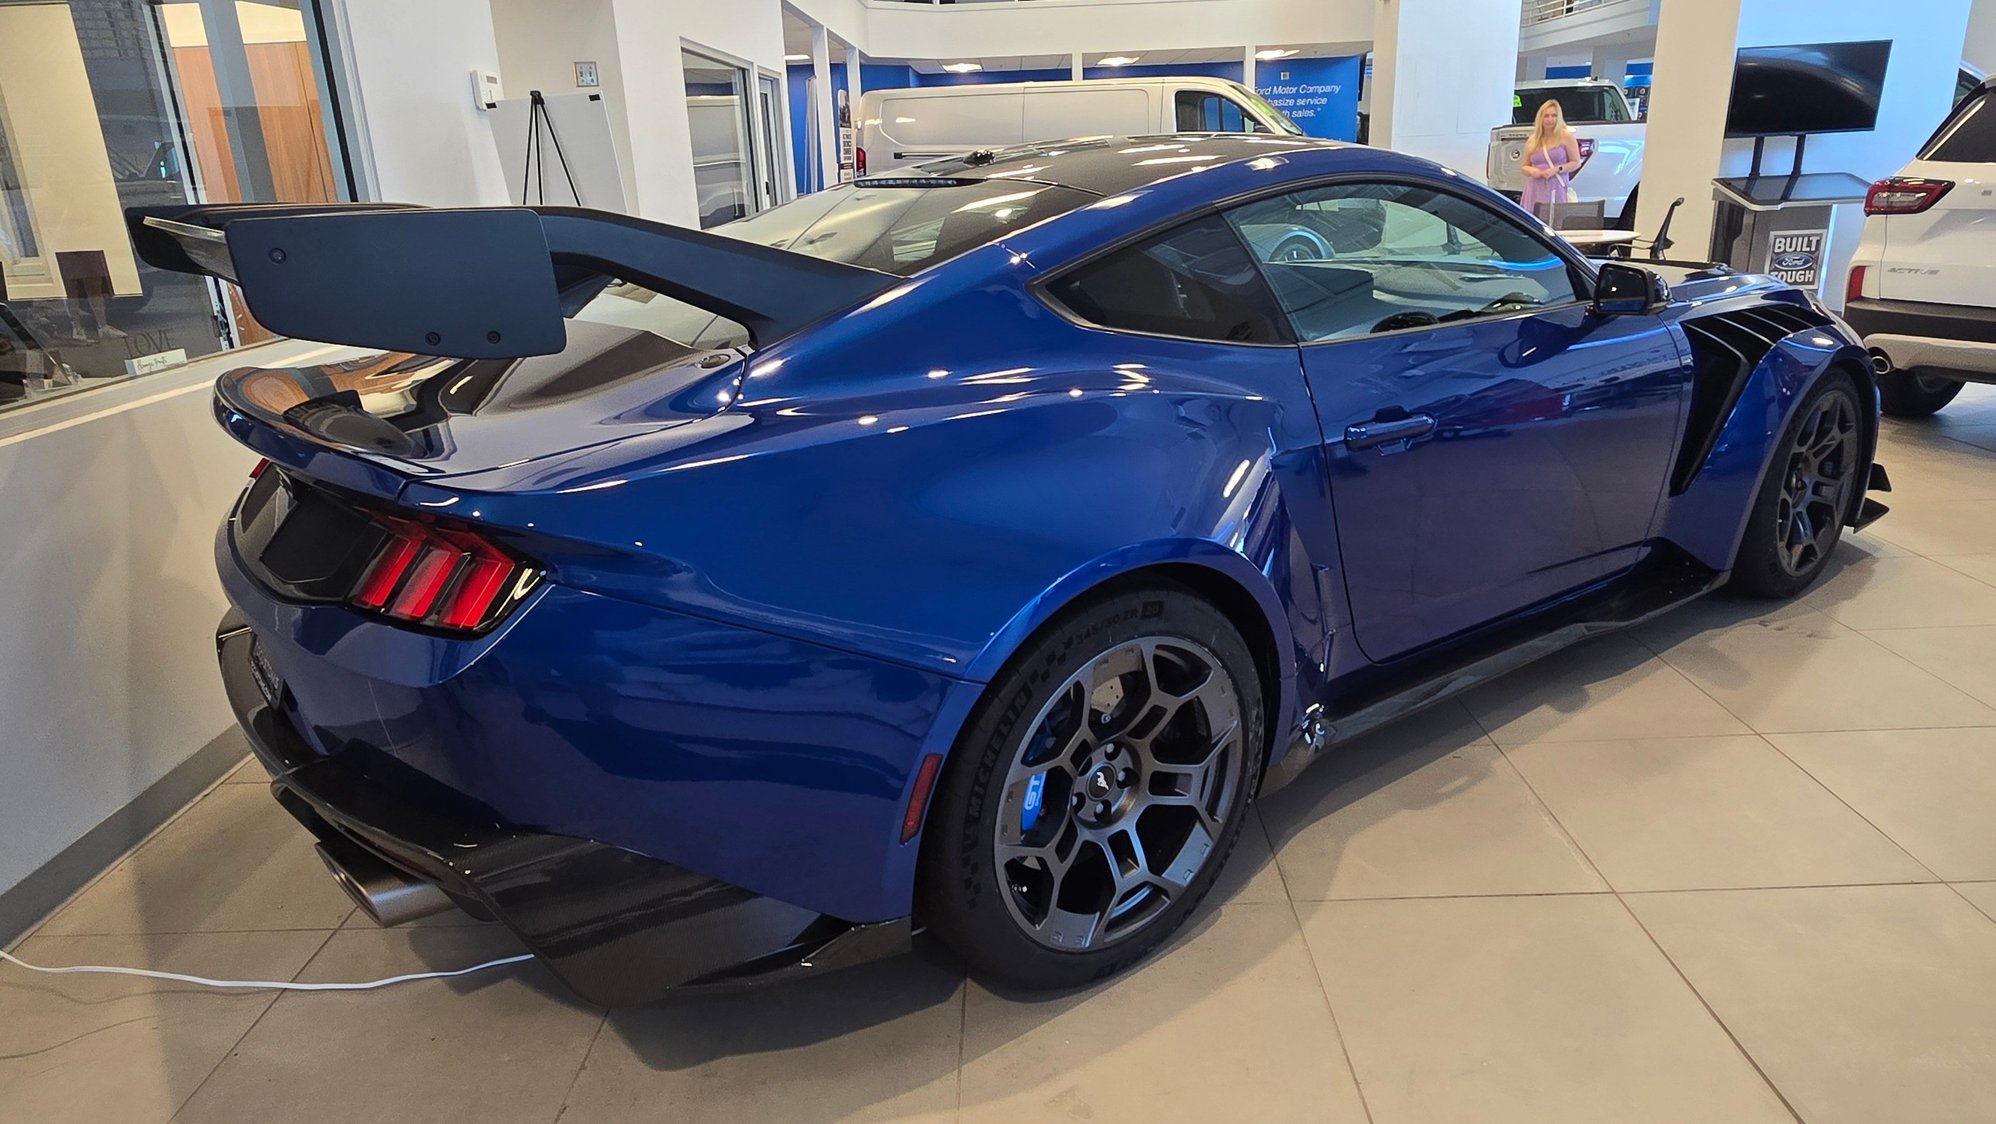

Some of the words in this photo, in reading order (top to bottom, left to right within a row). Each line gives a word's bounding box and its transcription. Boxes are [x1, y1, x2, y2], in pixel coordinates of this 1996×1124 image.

[1273, 85, 1298, 95] Motor
[1299, 84, 1341, 94] Company
[1296, 96, 1328, 105] service
[1774, 236, 1820, 252] BUILT
[1782, 256, 1806, 266] Ford
[1887, 267, 1940, 275] ACTIVE
[968, 687, 1031, 819] MICHELIN
[1024, 775, 1041, 812] GT
